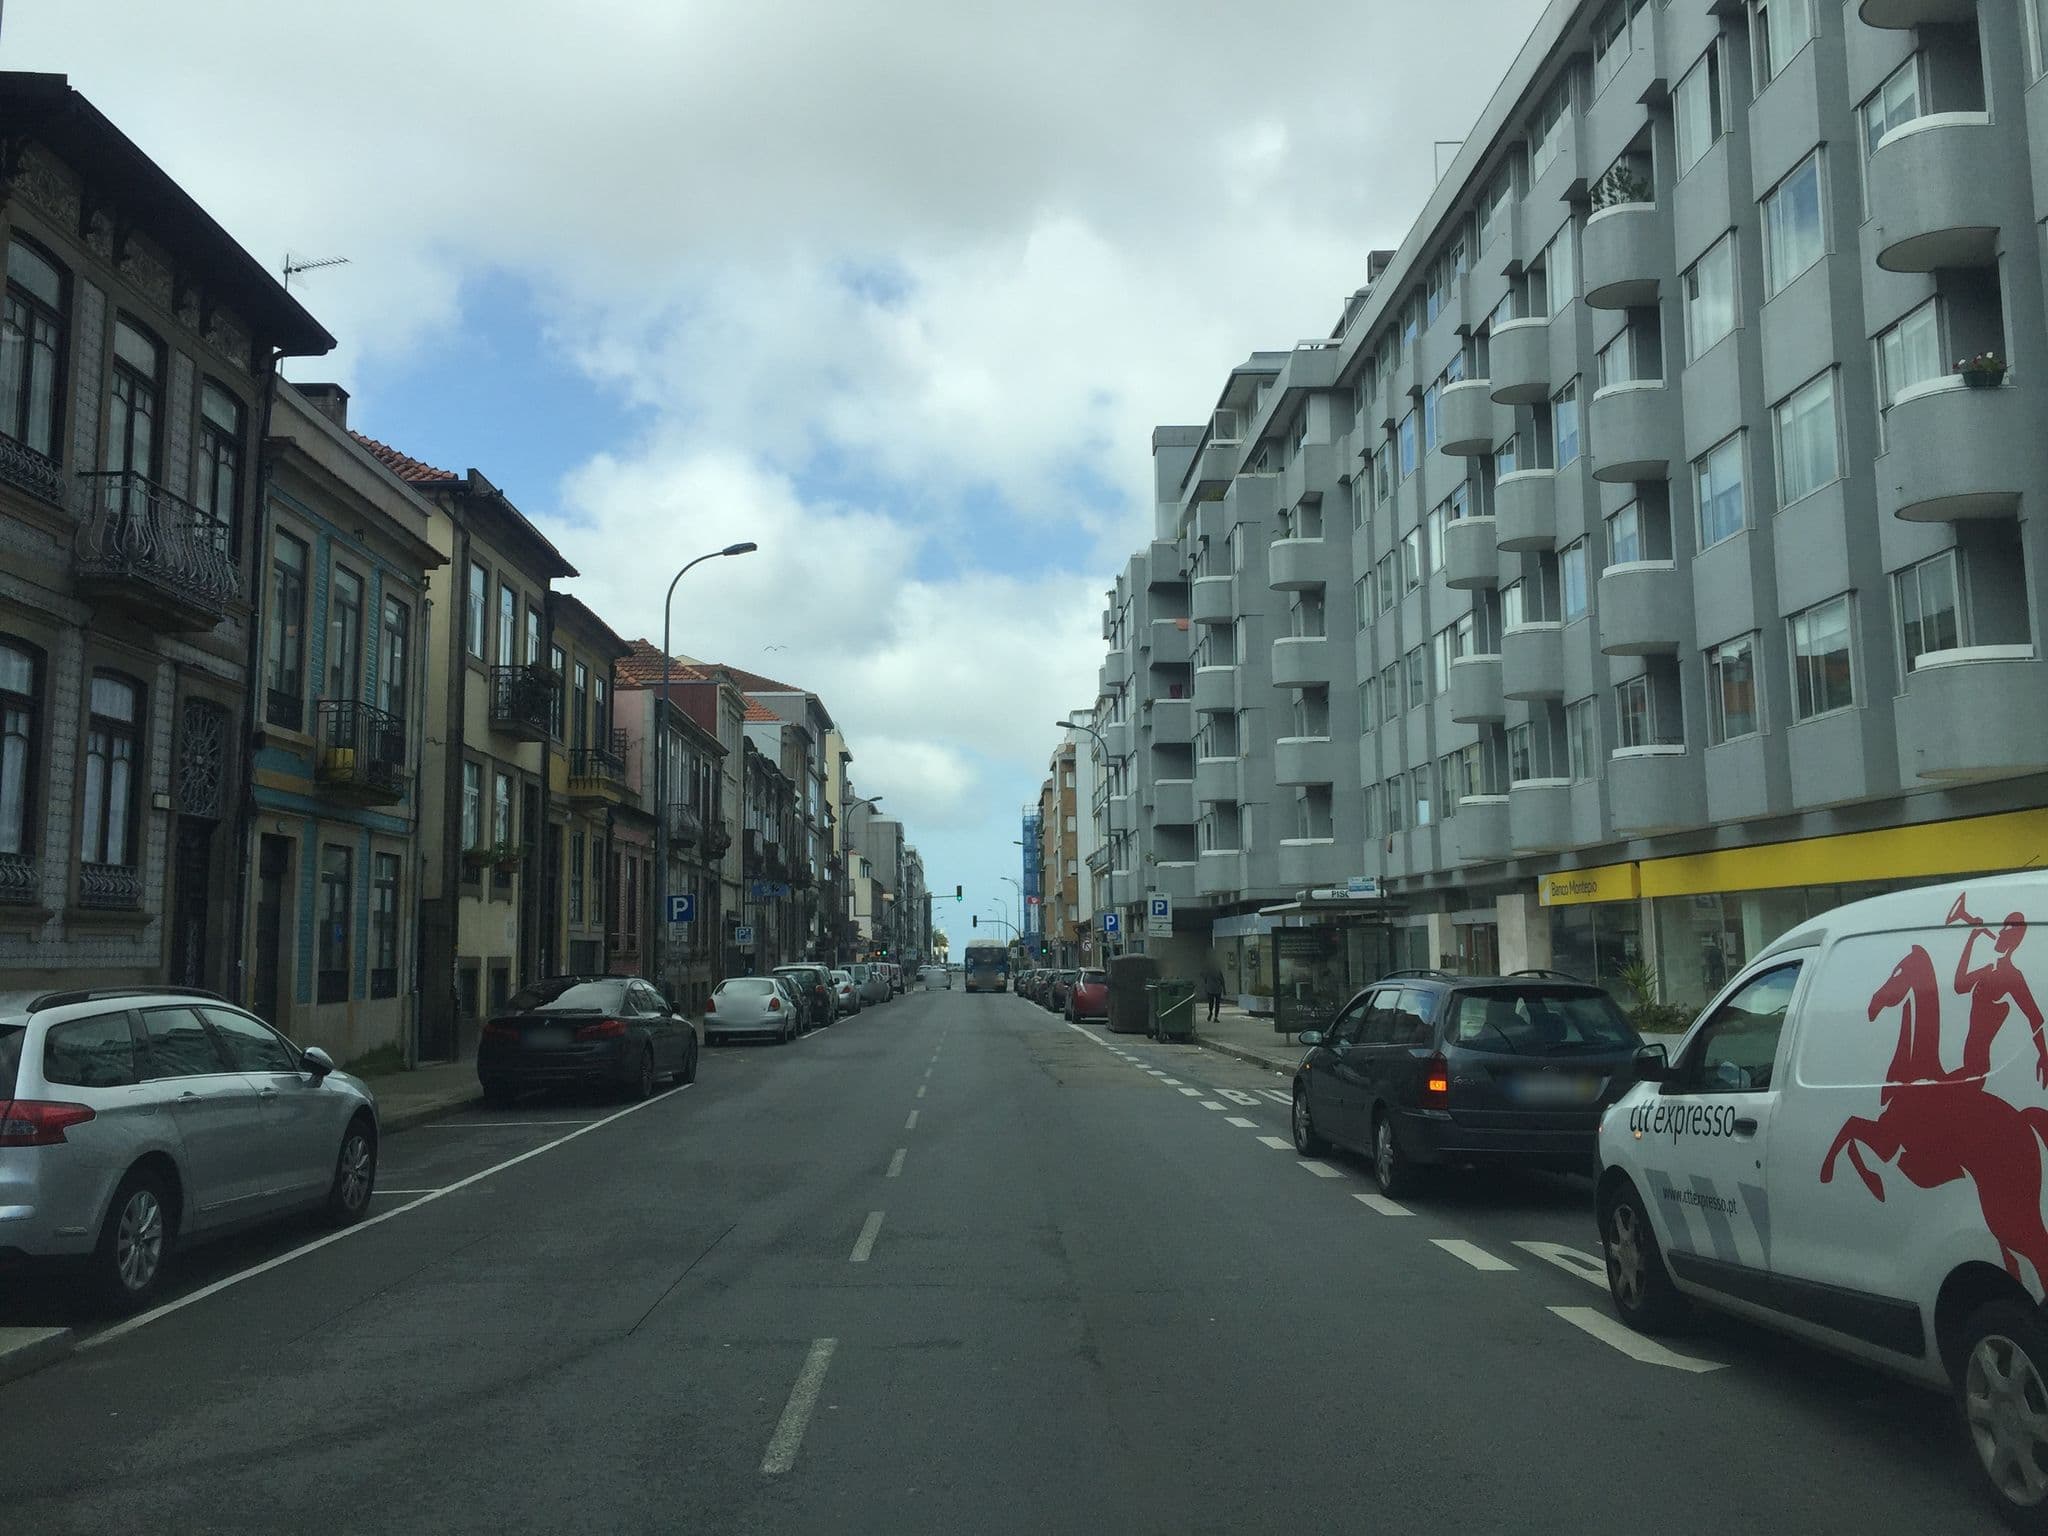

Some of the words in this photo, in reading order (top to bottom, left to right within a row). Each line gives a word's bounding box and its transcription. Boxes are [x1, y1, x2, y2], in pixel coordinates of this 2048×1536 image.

[673, 897, 688, 920] P
[1155, 901, 1165, 914] P
[1106, 915, 1116, 930] P
[1213, 1088, 1295, 1106] BU
[1630, 1099, 1654, 1133] ctt
[1654, 1104, 1736, 1145] expresso
[1663, 1187, 1737, 1217] www.cttexpresso.pt
